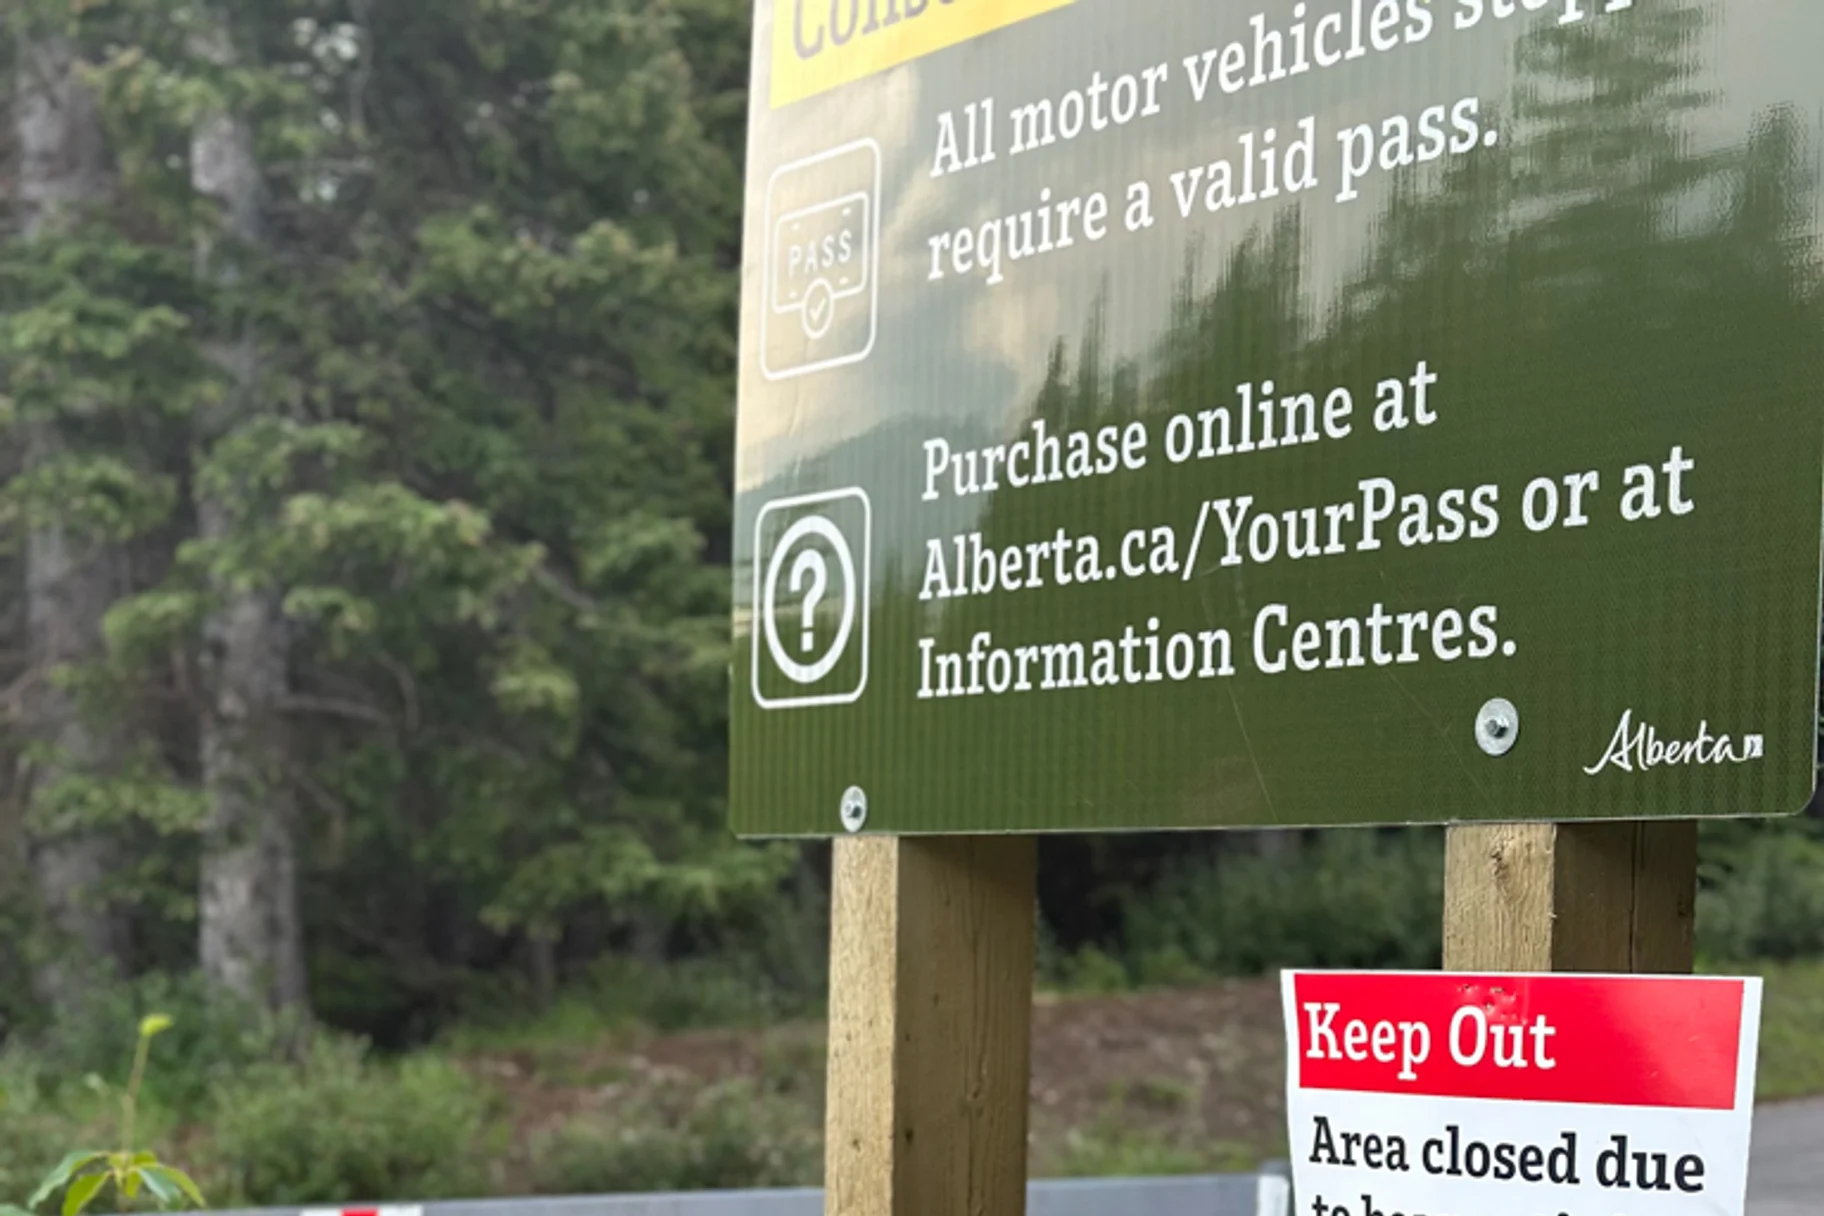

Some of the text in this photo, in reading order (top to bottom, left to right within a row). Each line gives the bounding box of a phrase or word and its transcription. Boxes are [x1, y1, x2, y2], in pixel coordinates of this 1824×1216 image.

[928, 0, 1434, 179] All motor vehicles
[927, 95, 1499, 285] require a valid pass.
[788, 229, 852, 279] PASS
[921, 361, 1438, 501] Purchase online at
[918, 446, 1695, 600] Alberta.ca/YourPass or at
[916, 602, 1517, 699] Information Centres.
[1583, 708, 1746, 775] Alberta
[1303, 1001, 1557, 1082] Keep Out
[1309, 1115, 1706, 1193] Area closed due
